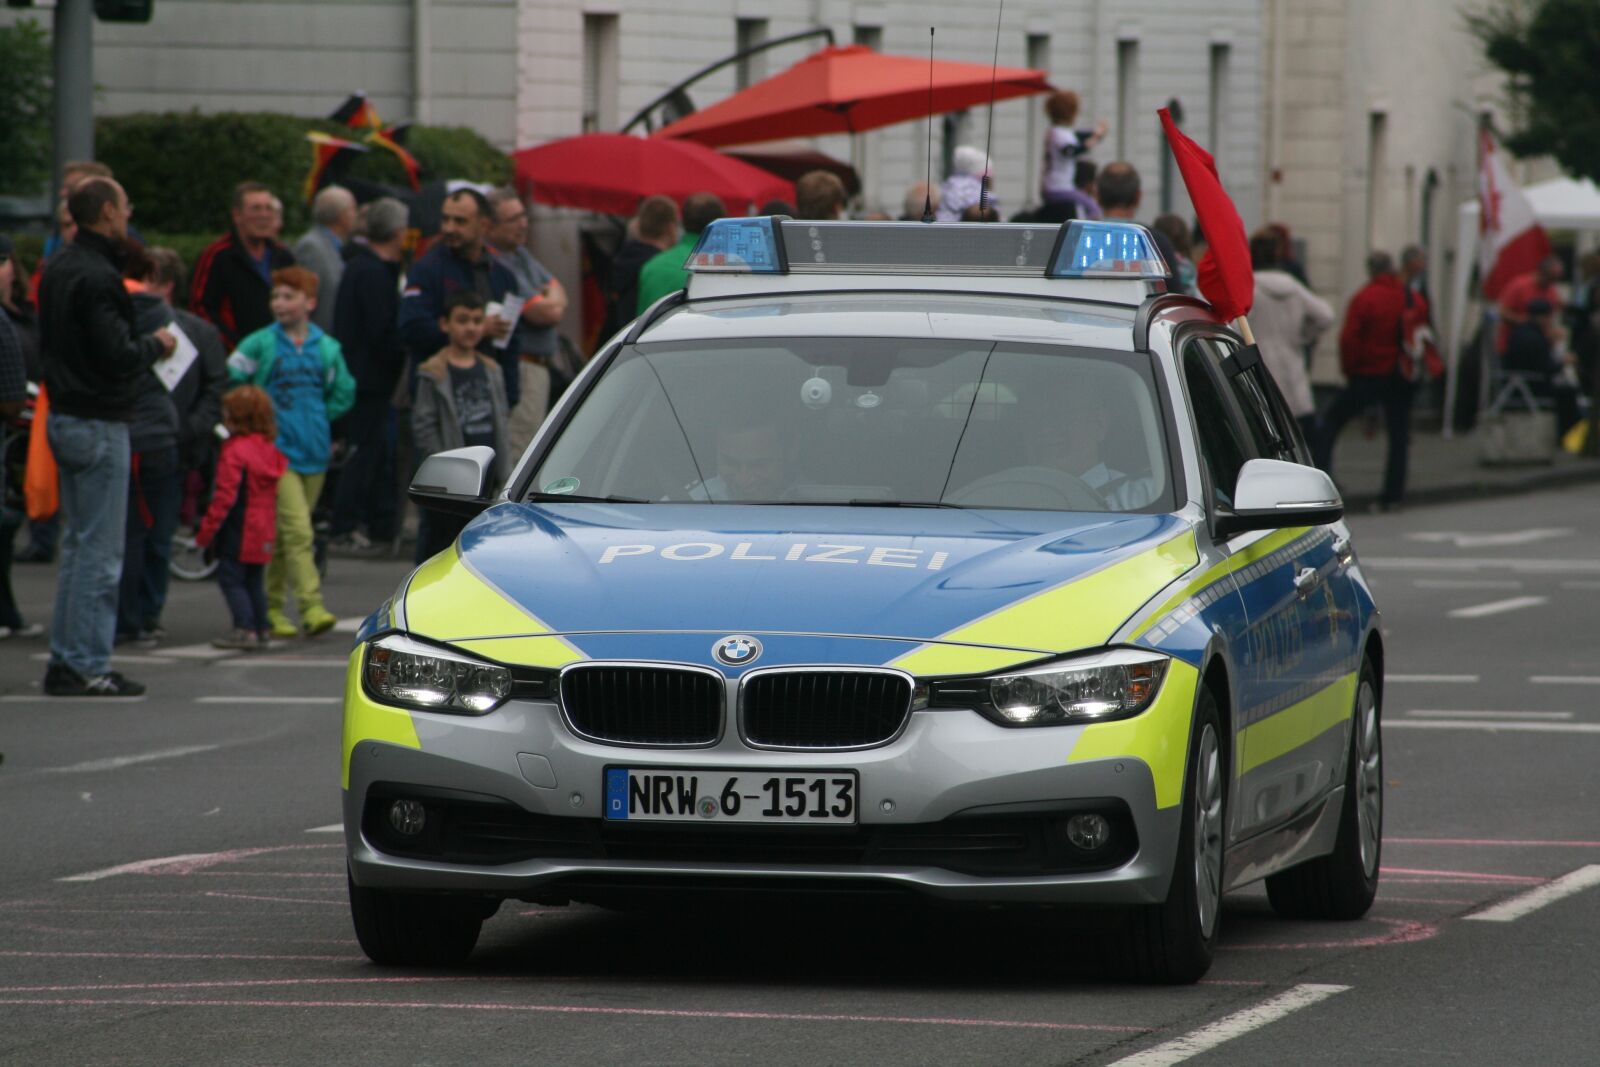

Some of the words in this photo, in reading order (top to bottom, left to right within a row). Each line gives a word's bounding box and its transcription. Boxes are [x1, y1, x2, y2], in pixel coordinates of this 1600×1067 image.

[599, 542, 949, 570] POLIZEI
[612, 799, 622, 811] D
[629, 775, 698, 815] NRW
[720, 777, 853, 818] 6-1513
